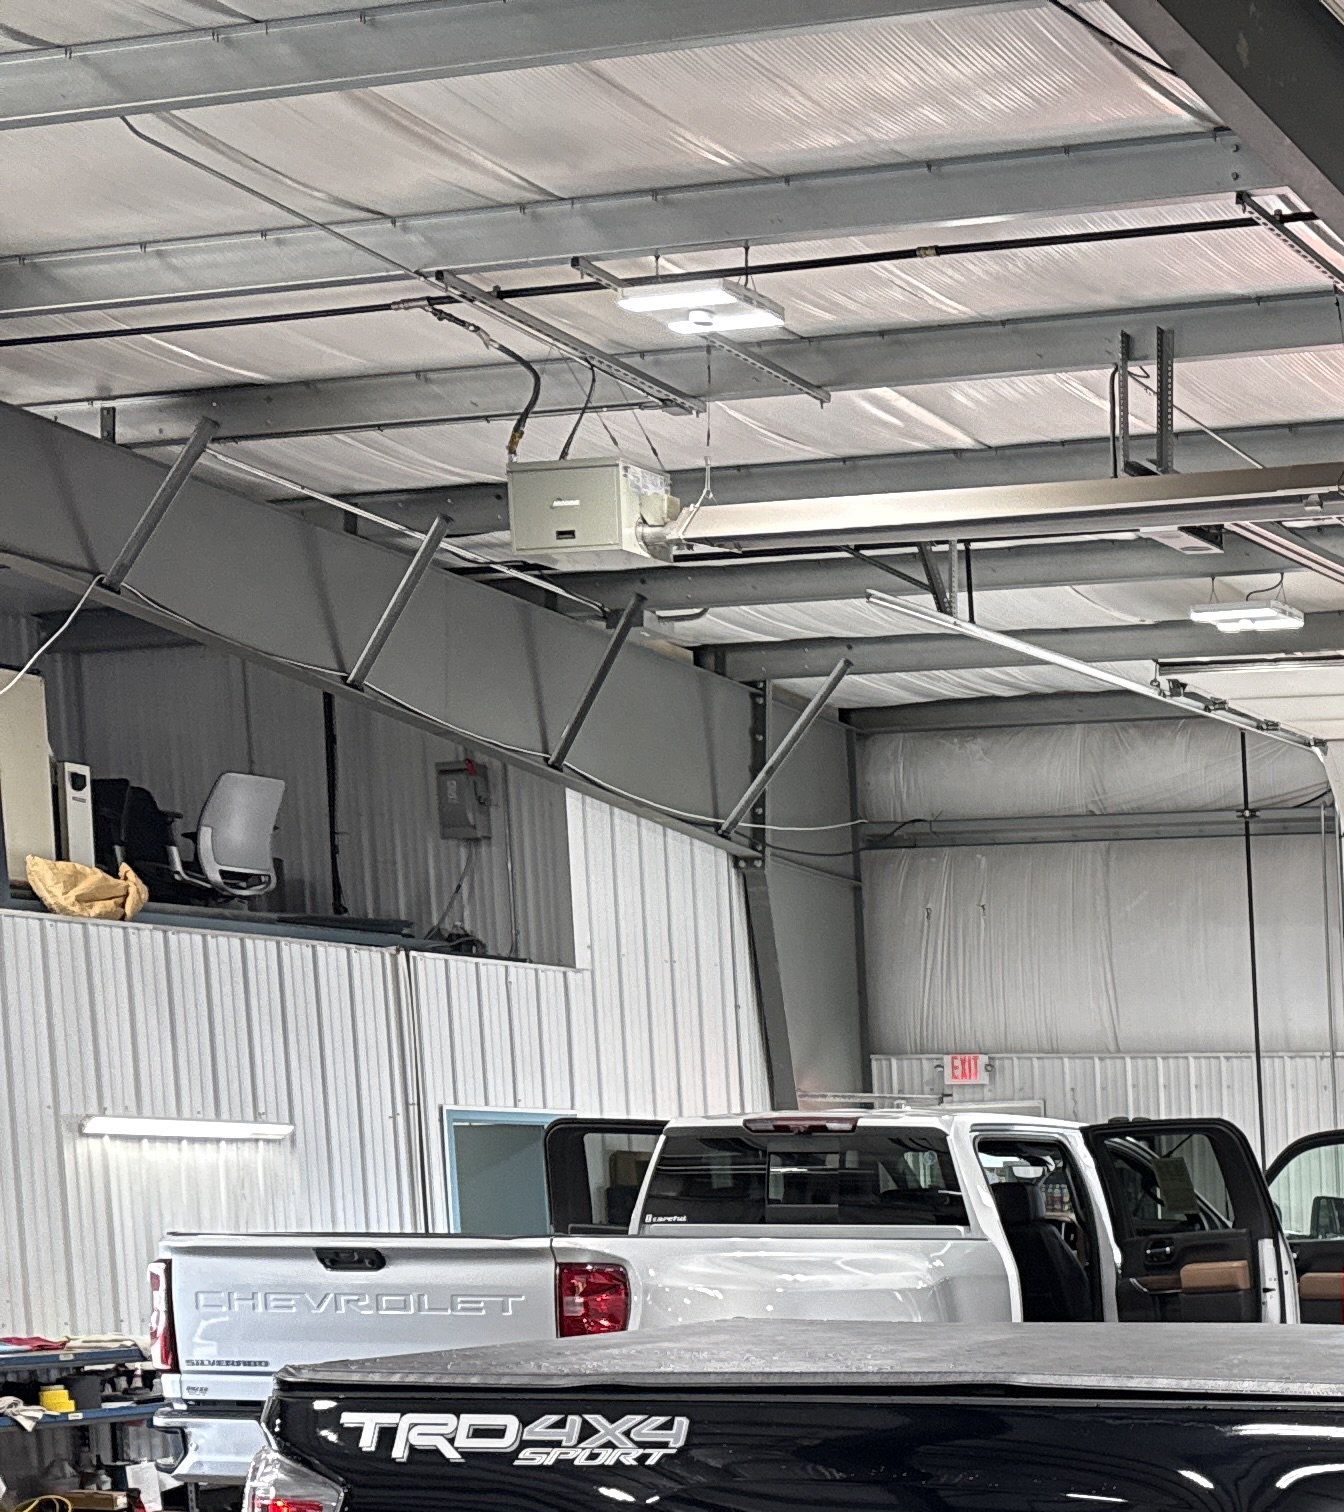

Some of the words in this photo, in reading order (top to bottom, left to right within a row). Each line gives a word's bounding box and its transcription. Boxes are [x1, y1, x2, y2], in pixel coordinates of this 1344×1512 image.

[951, 1055, 979, 1080] EXIT
[195, 1290, 525, 1316] CHEVROLET
[185, 1359, 270, 1368] SILVERADO
[339, 1411, 526, 1463] TRD
[522, 1414, 690, 1449] 4X4
[512, 1447, 677, 1466] SPORT
